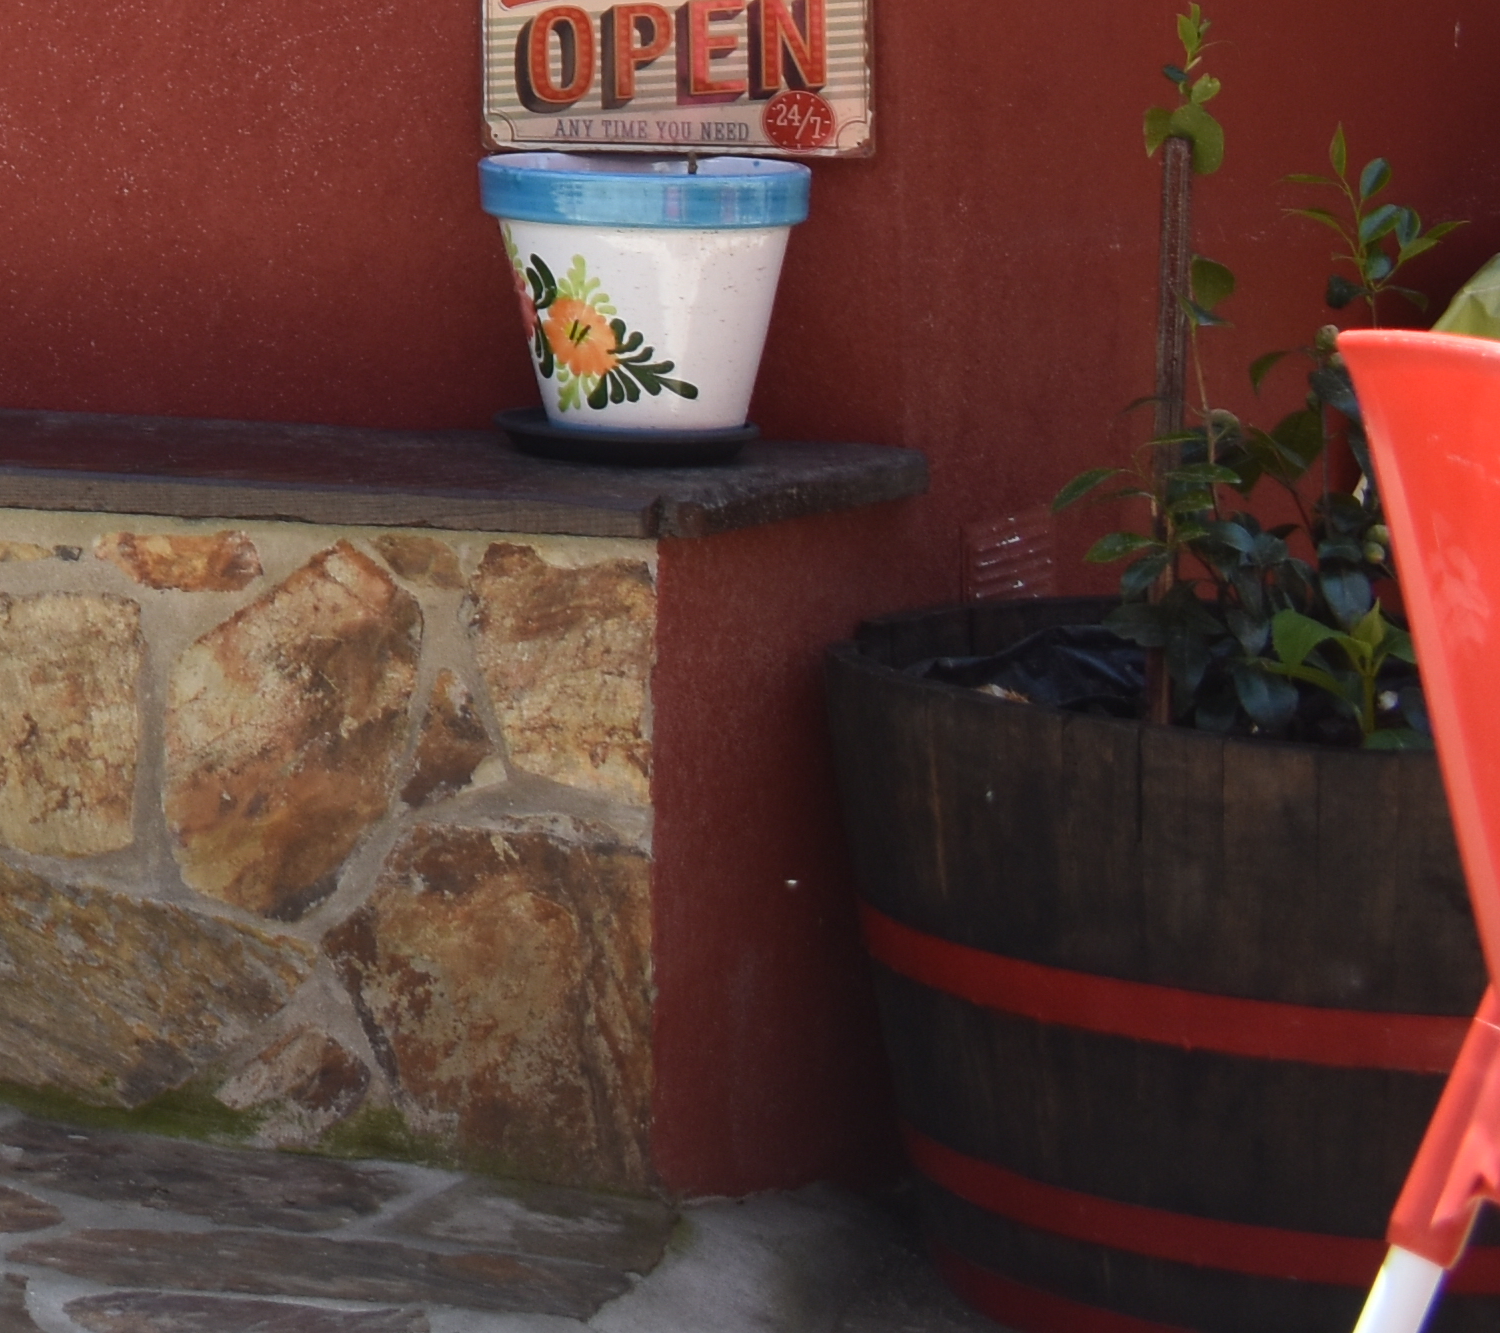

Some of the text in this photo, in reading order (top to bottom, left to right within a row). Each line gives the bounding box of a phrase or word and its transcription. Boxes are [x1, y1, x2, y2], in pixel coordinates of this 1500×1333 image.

[553, 118, 750, 141] ANY TIME YOU NEED
[775, 103, 822, 140] 24/7
